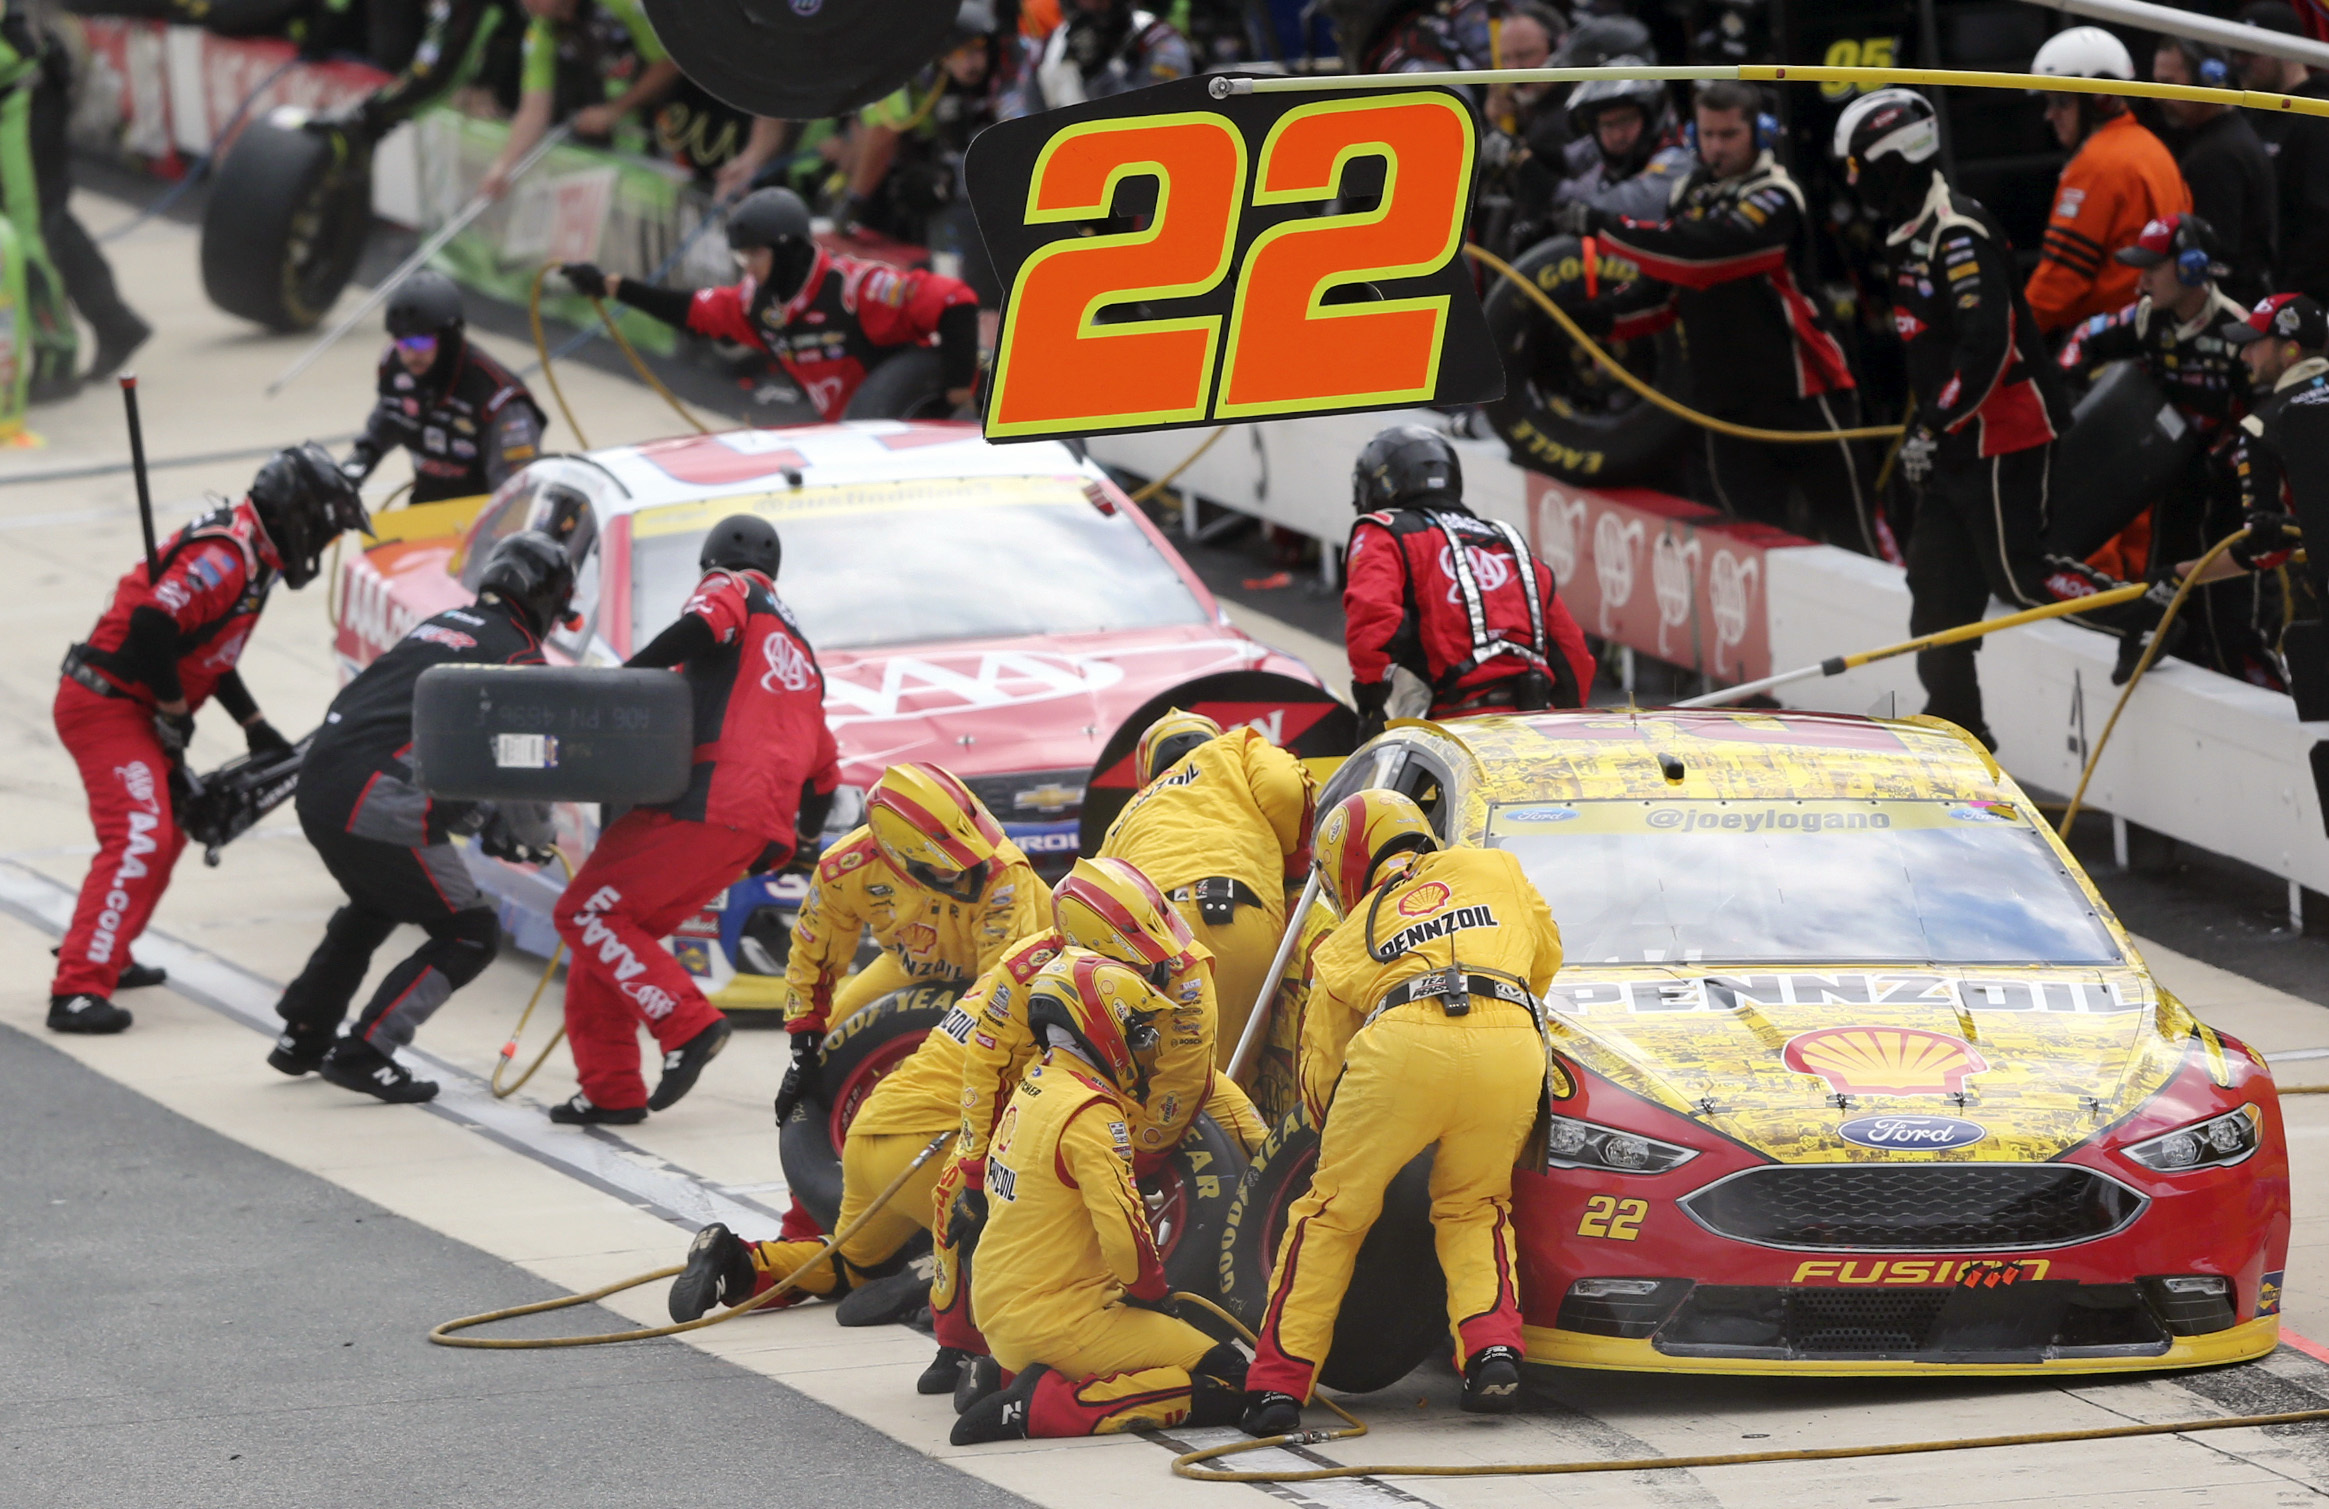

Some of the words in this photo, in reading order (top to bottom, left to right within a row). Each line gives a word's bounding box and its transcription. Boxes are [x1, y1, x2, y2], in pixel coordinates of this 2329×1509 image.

[984, 91, 1476, 438] 22
[1517, 809, 1564, 821] Ford
[1645, 807, 1891, 833] @joeylogano
[86, 811, 158, 964] AAA.com
[1379, 904, 1500, 966] PENNZOIL
[1547, 973, 2158, 1016] PENNZOIL
[1867, 1119, 1955, 1142] Ford
[936, 1165, 959, 1251] Shell
[1576, 1194, 1649, 1242] 22
